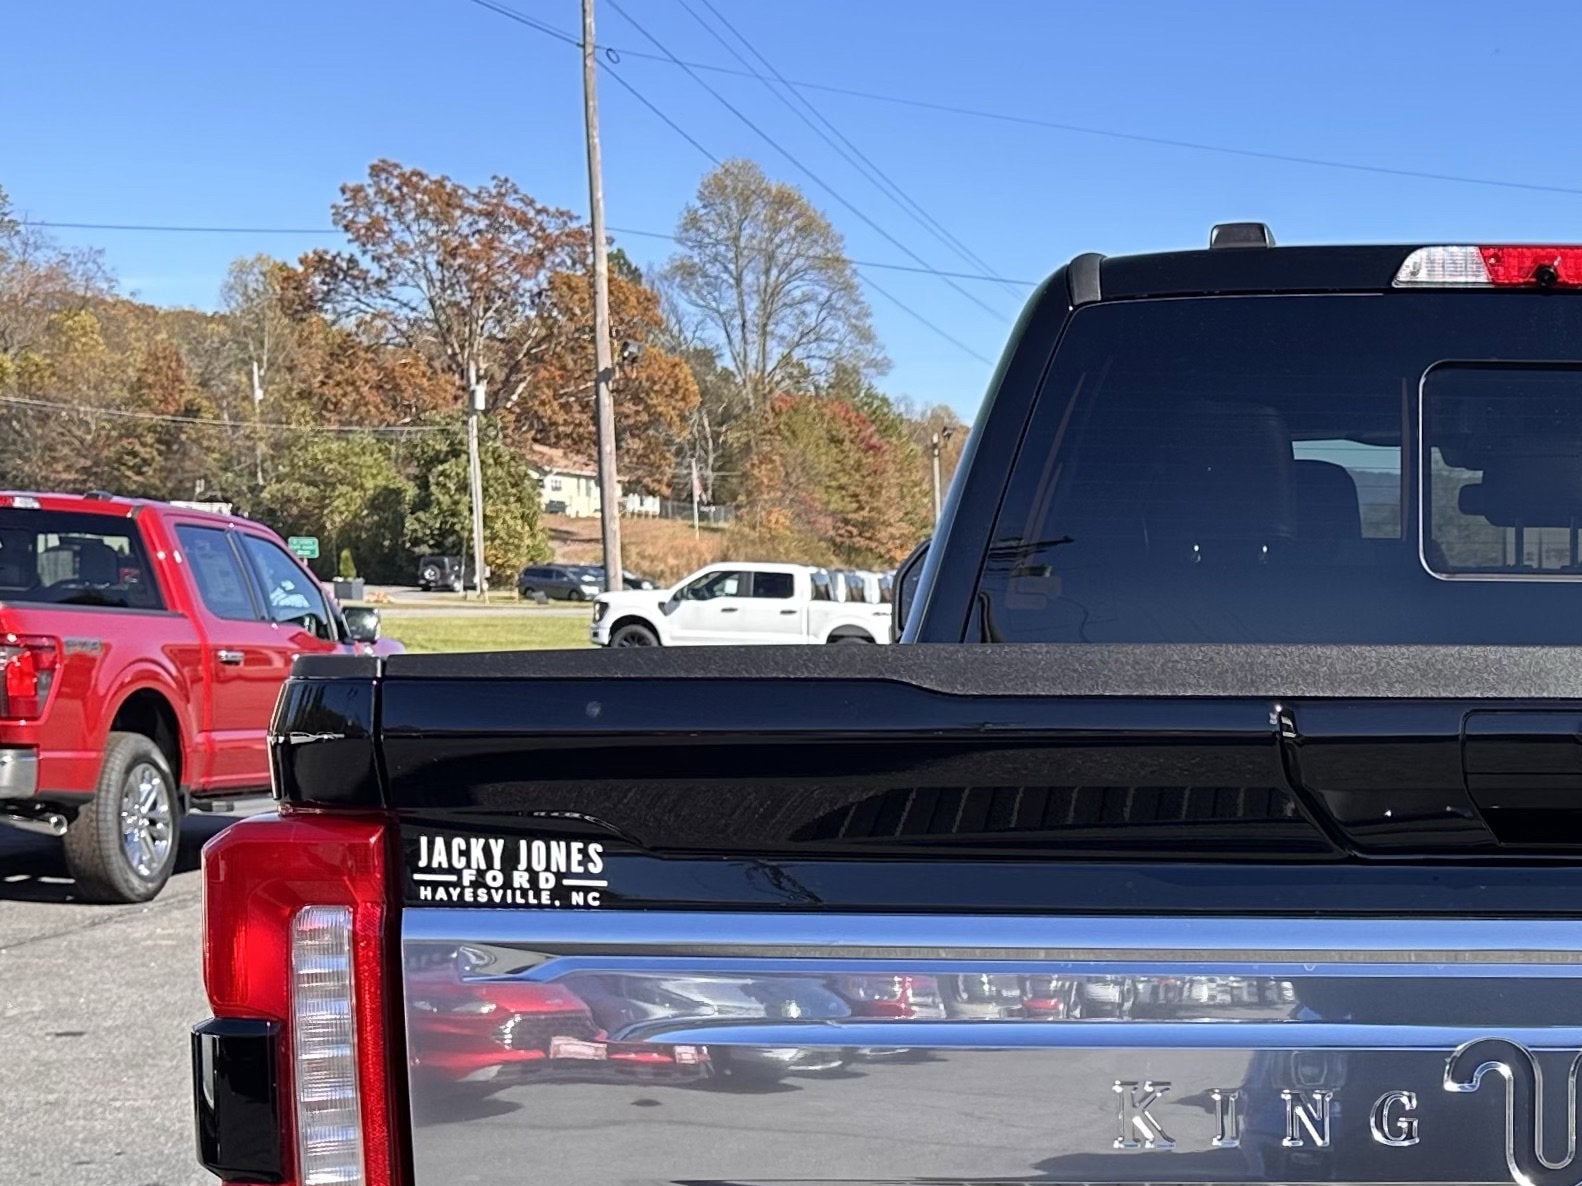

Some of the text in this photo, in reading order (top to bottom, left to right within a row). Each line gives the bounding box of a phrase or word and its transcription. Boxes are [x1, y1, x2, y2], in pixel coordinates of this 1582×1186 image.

[418, 836, 604, 873] JACKY JONES
[462, 869, 556, 889] FORD
[419, 886, 601, 907] HAYESVILLE, NC
[1112, 1080, 1420, 1148] KING
